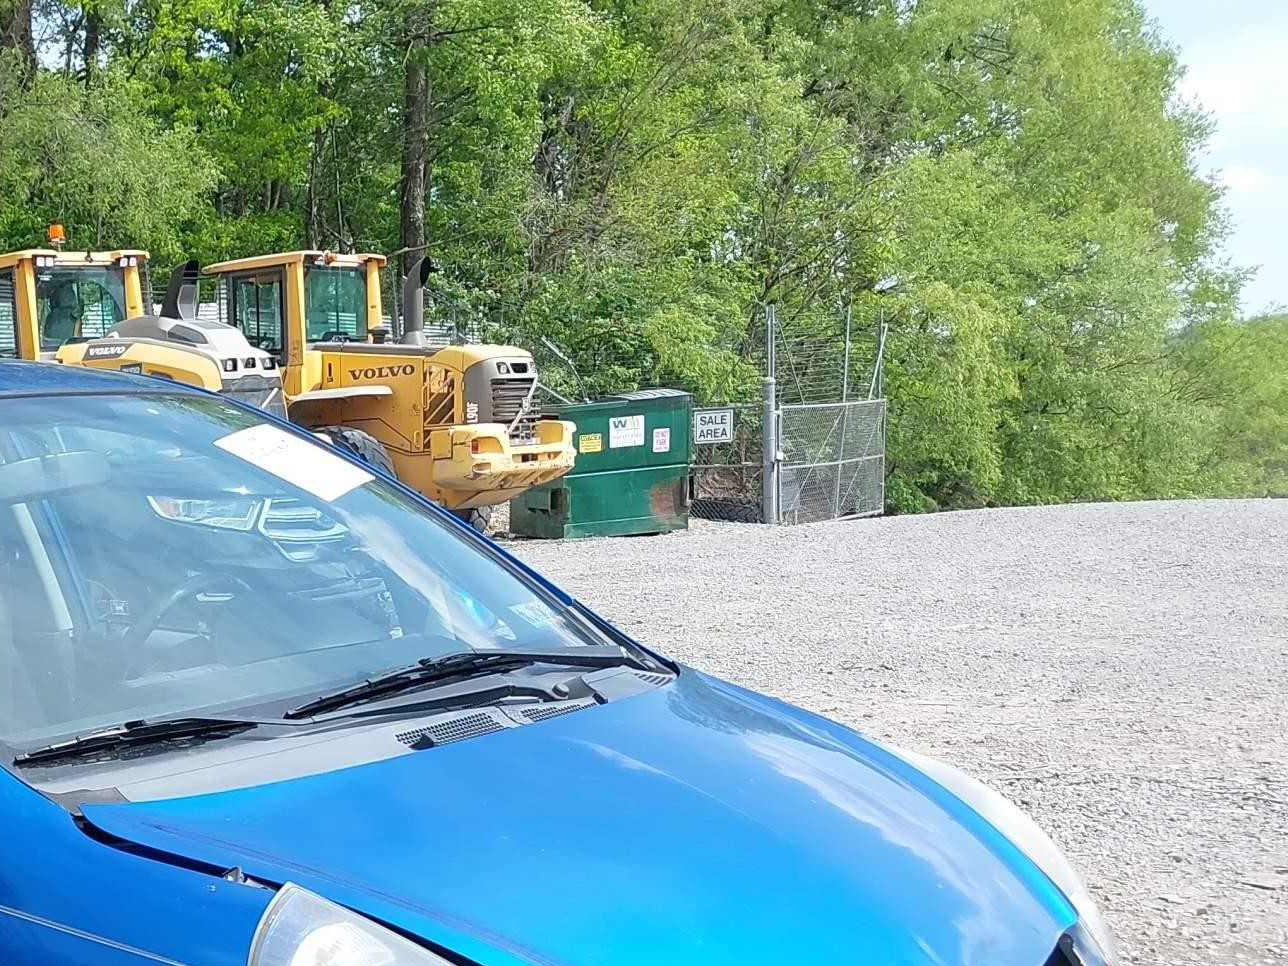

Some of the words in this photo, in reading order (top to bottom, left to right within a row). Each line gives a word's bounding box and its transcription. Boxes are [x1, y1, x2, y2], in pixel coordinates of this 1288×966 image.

[88, 346, 126, 357] VOLVO
[348, 364, 416, 381] VOLVO
[466, 401, 479, 424] L90F
[699, 414, 728, 426] SALE
[698, 427, 728, 440] AREA
